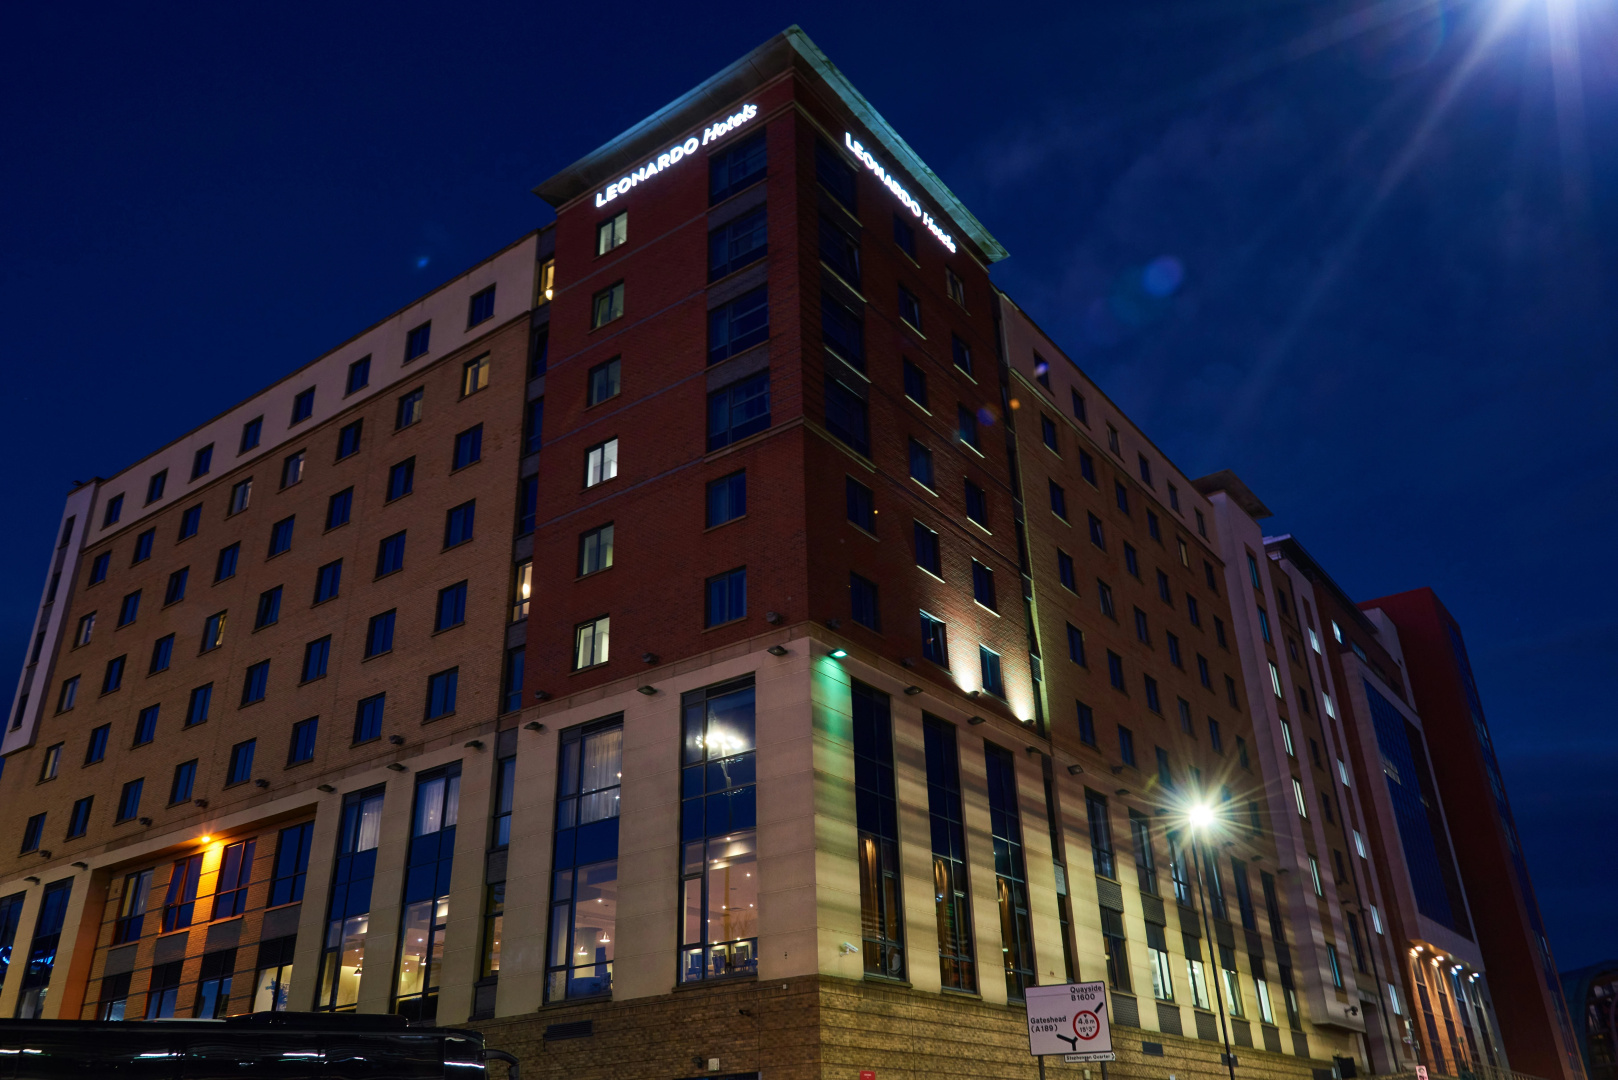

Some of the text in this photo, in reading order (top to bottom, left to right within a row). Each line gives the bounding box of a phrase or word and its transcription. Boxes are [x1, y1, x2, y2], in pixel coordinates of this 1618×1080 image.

[595, 104, 757, 208] LEONARDO Hotels
[845, 131, 922, 218] LEONARDO
[1070, 985, 1102, 994] Quayside
[1071, 993, 1096, 1001] B1600
[1030, 1015, 1067, 1024] Gateshead
[1031, 1024, 1058, 1033] (A189)
